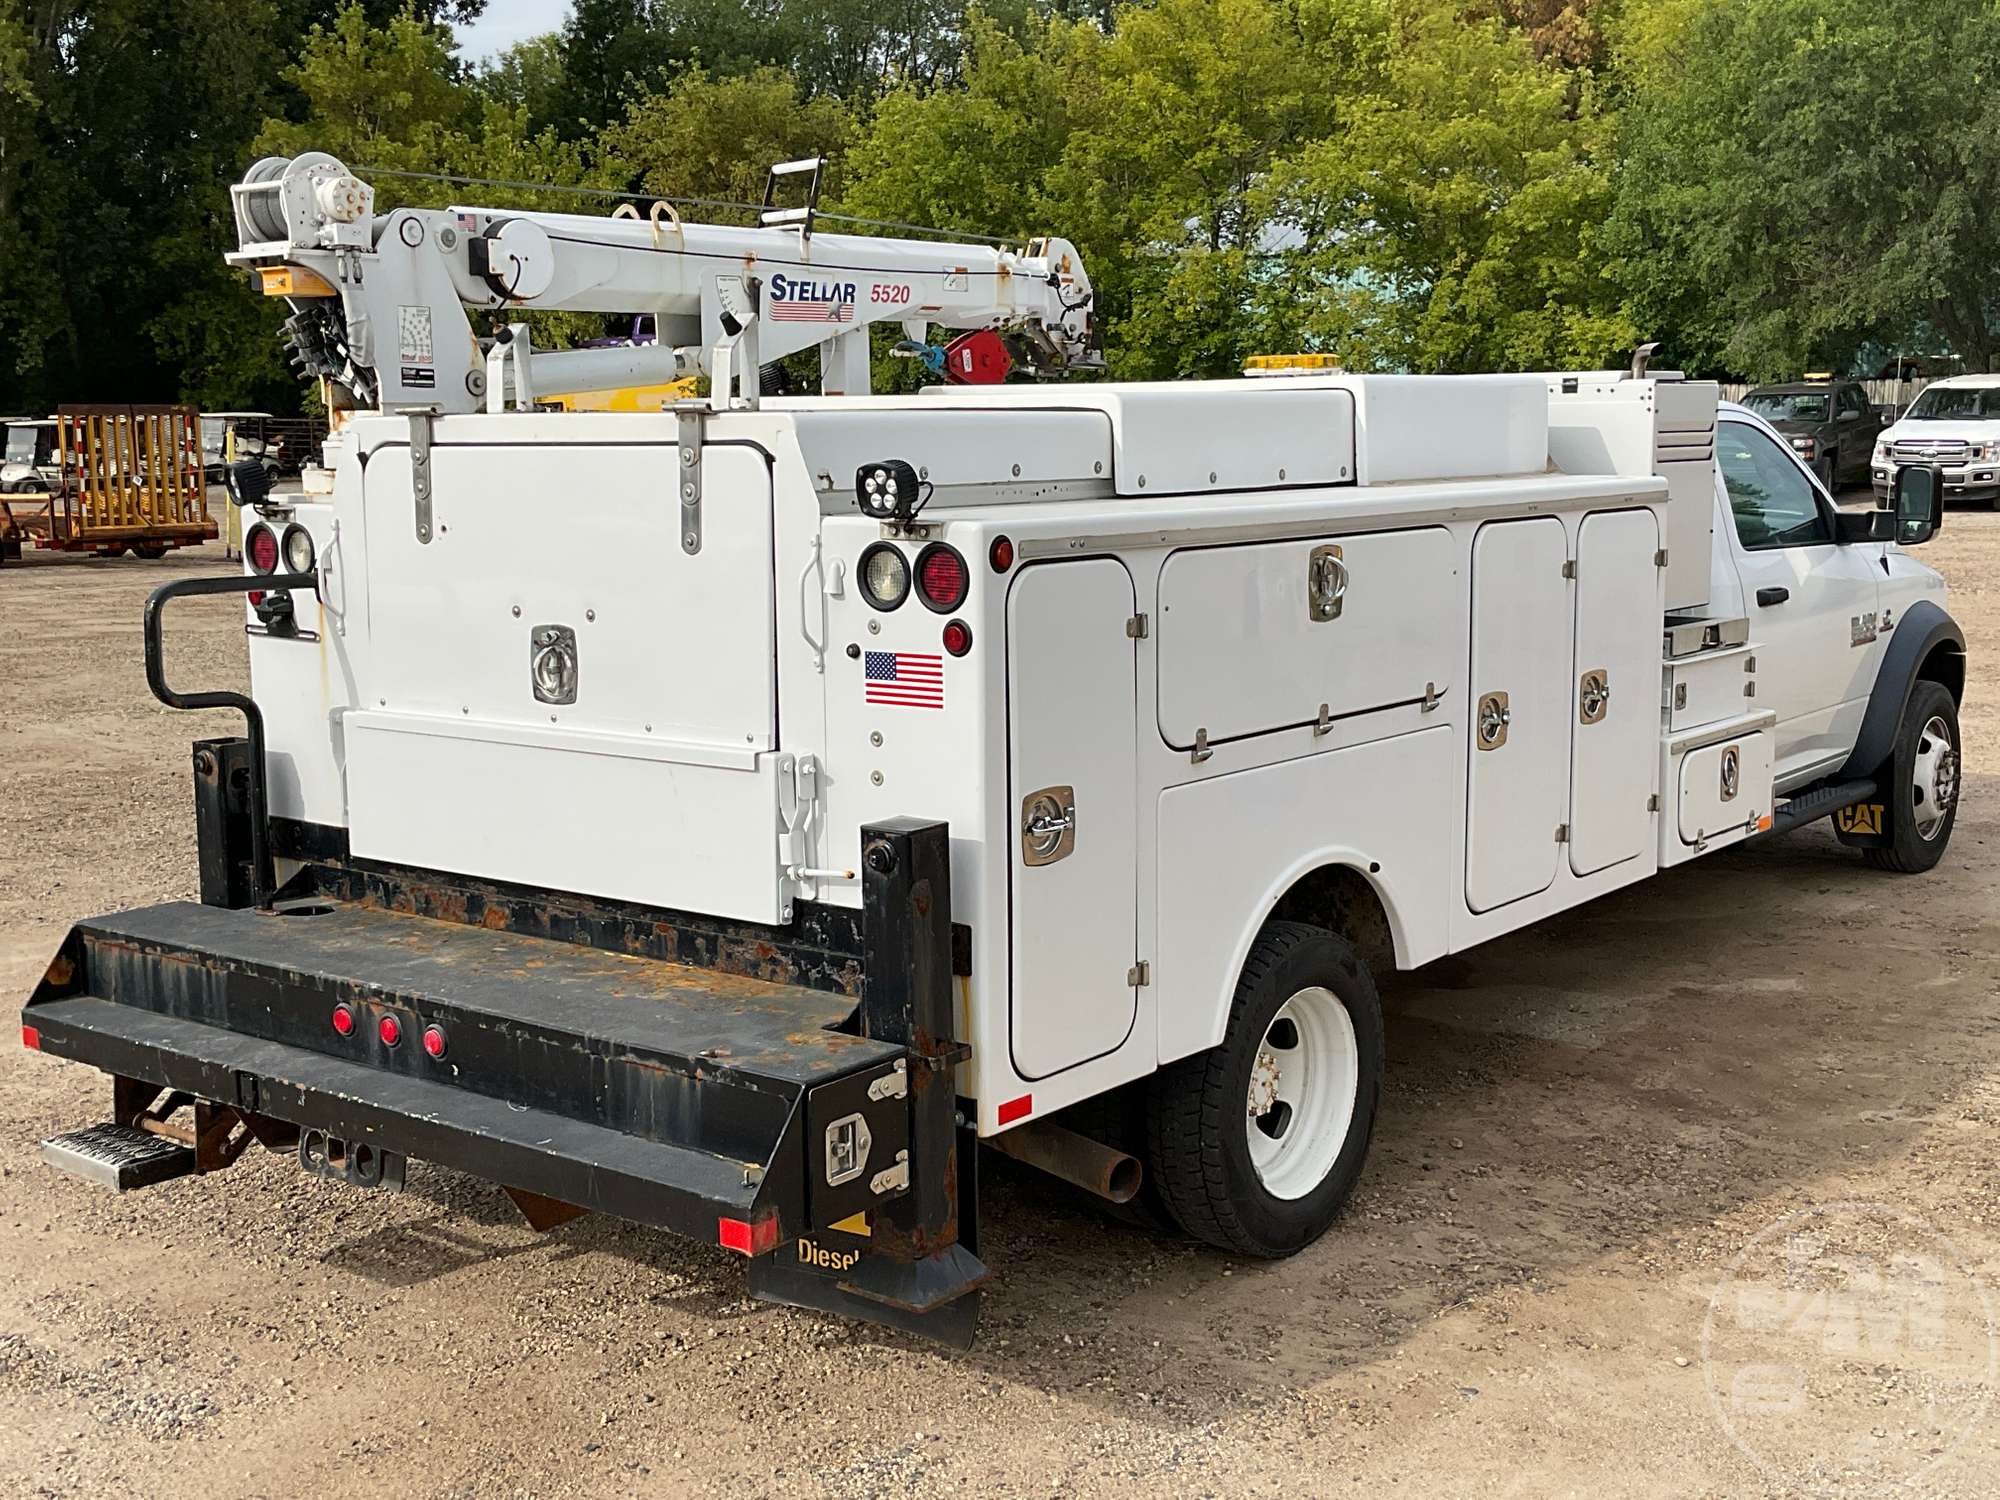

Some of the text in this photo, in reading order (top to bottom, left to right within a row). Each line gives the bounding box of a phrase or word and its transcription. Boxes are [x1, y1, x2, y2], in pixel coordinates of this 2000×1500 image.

[770, 273, 910, 304] STELLAR 5520
[1837, 804, 1884, 834] CAT
